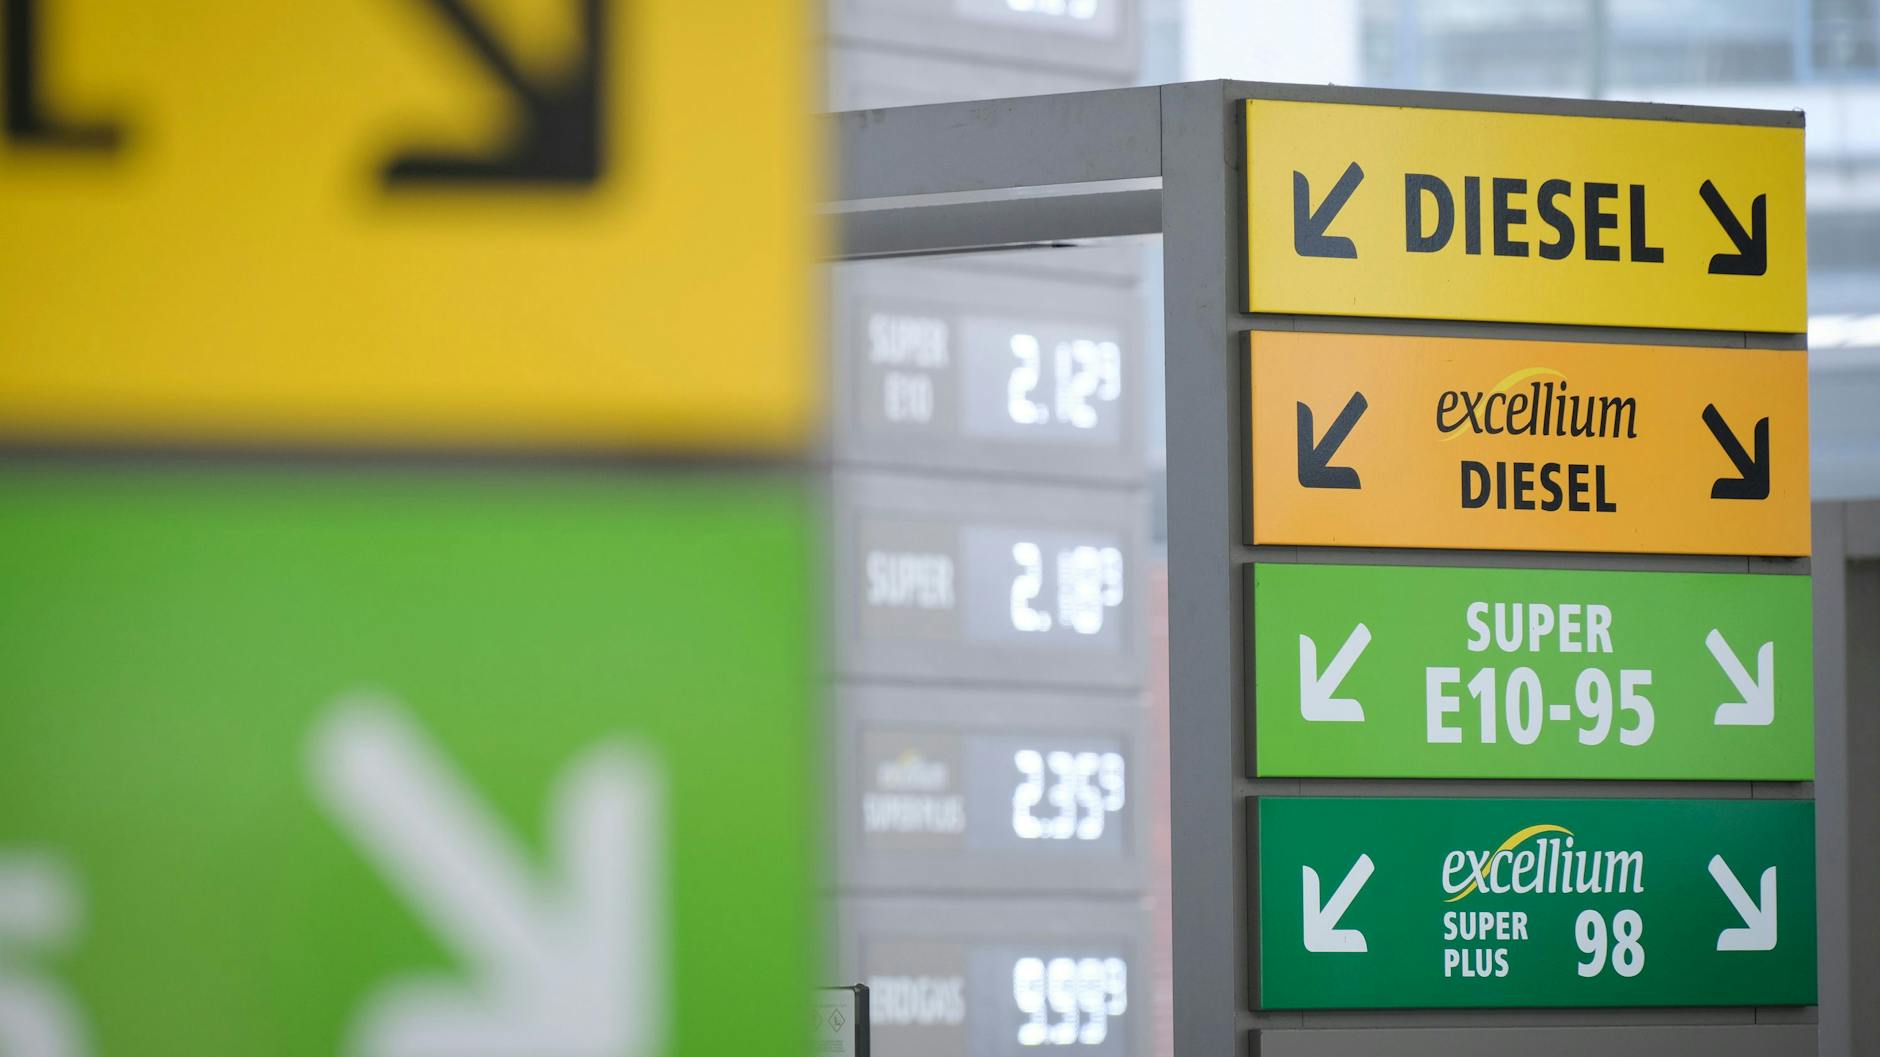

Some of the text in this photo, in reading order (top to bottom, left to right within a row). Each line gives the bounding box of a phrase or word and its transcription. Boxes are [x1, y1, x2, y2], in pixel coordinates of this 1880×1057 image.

[1404, 172, 1665, 264] DIESEL
[1436, 380, 1638, 440] excellium
[1461, 460, 1618, 513] DIESEL
[1466, 601, 1613, 653] SUPER
[1426, 666, 1655, 746] E10-95
[1441, 834, 1645, 895] excellium
[1443, 911, 1528, 941] SUPER
[1575, 909, 1646, 978] 98
[1444, 948, 1510, 978] PLUS
